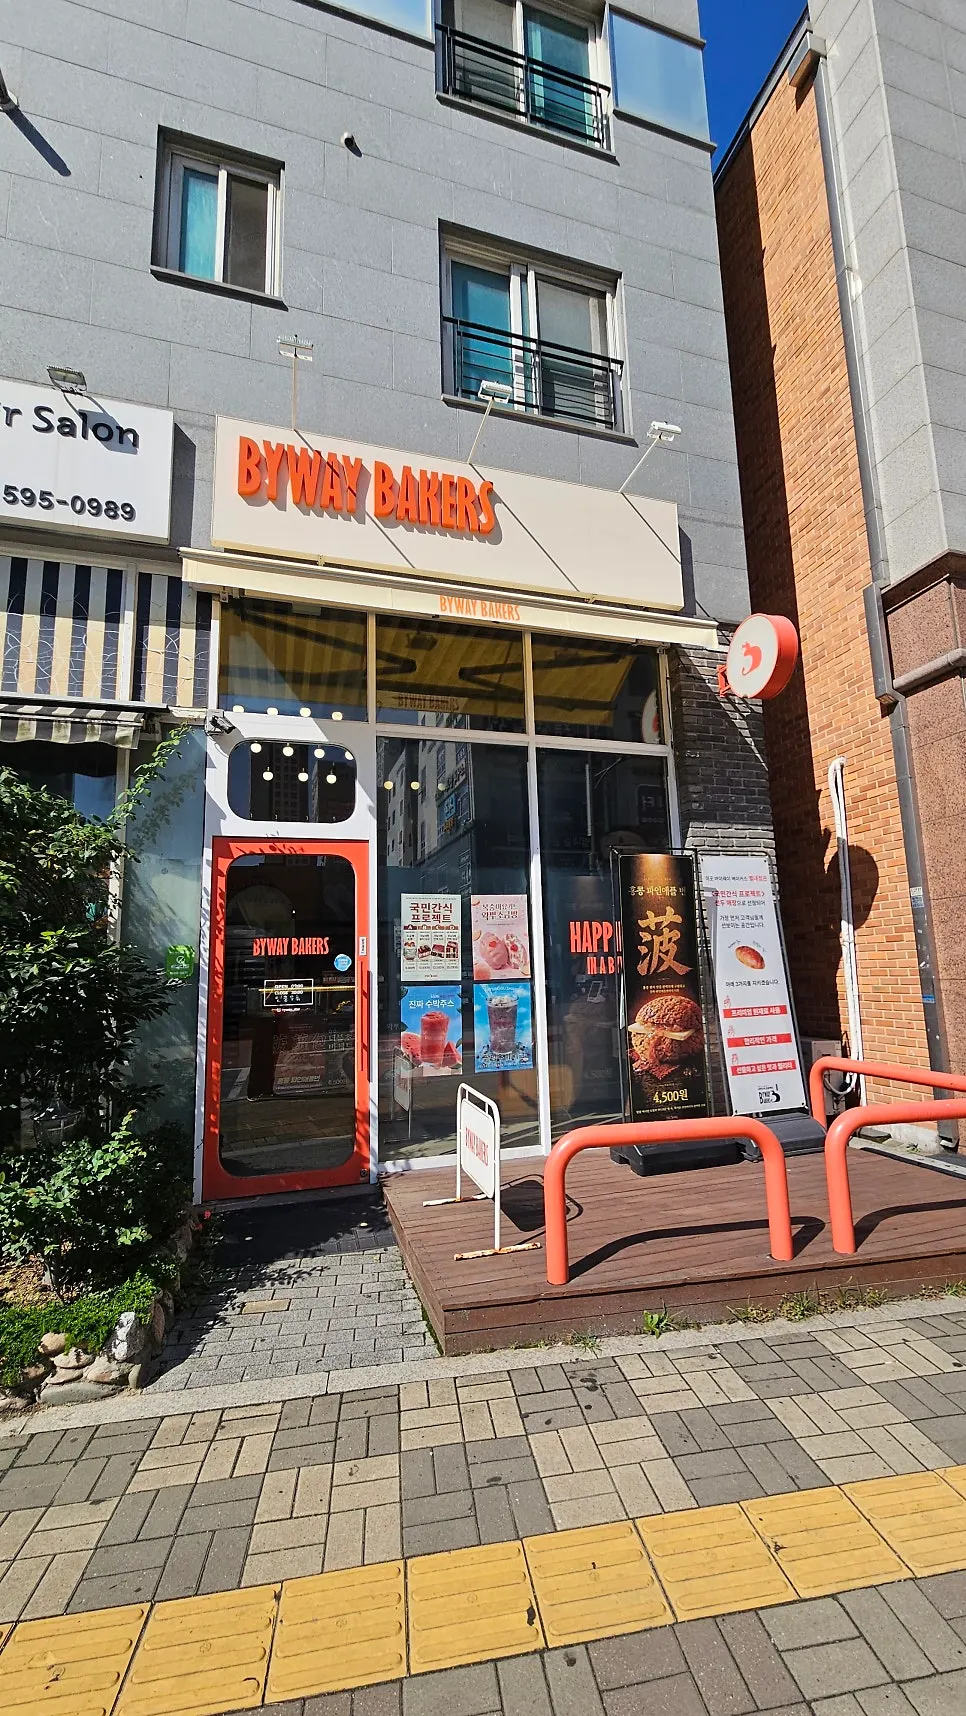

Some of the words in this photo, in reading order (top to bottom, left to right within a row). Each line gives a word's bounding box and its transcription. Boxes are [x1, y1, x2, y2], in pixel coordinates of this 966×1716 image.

[32, 405, 139, 450] Salon
[238, 435, 363, 514] BYWAY
[374, 460, 494, 534] BAKERS
[3, 484, 136, 522] 595-0989
[439, 594, 477, 617] BYWAY
[480, 600, 520, 622] BAKERS
[646, 885, 678, 896] 파인애플
[410, 902, 453, 914] 국민간식
[411, 913, 452, 923] 프로젝트
[252, 937, 290, 956] BYWAY
[291, 936, 330, 956] BAKERS
[637, 905, 694, 976] 菠
[587, 956, 597, 975] IN
[599, 956, 607, 975] A
[425, 999, 455, 1008] 수박주스
[653, 1088, 689, 1104] 4,500원
